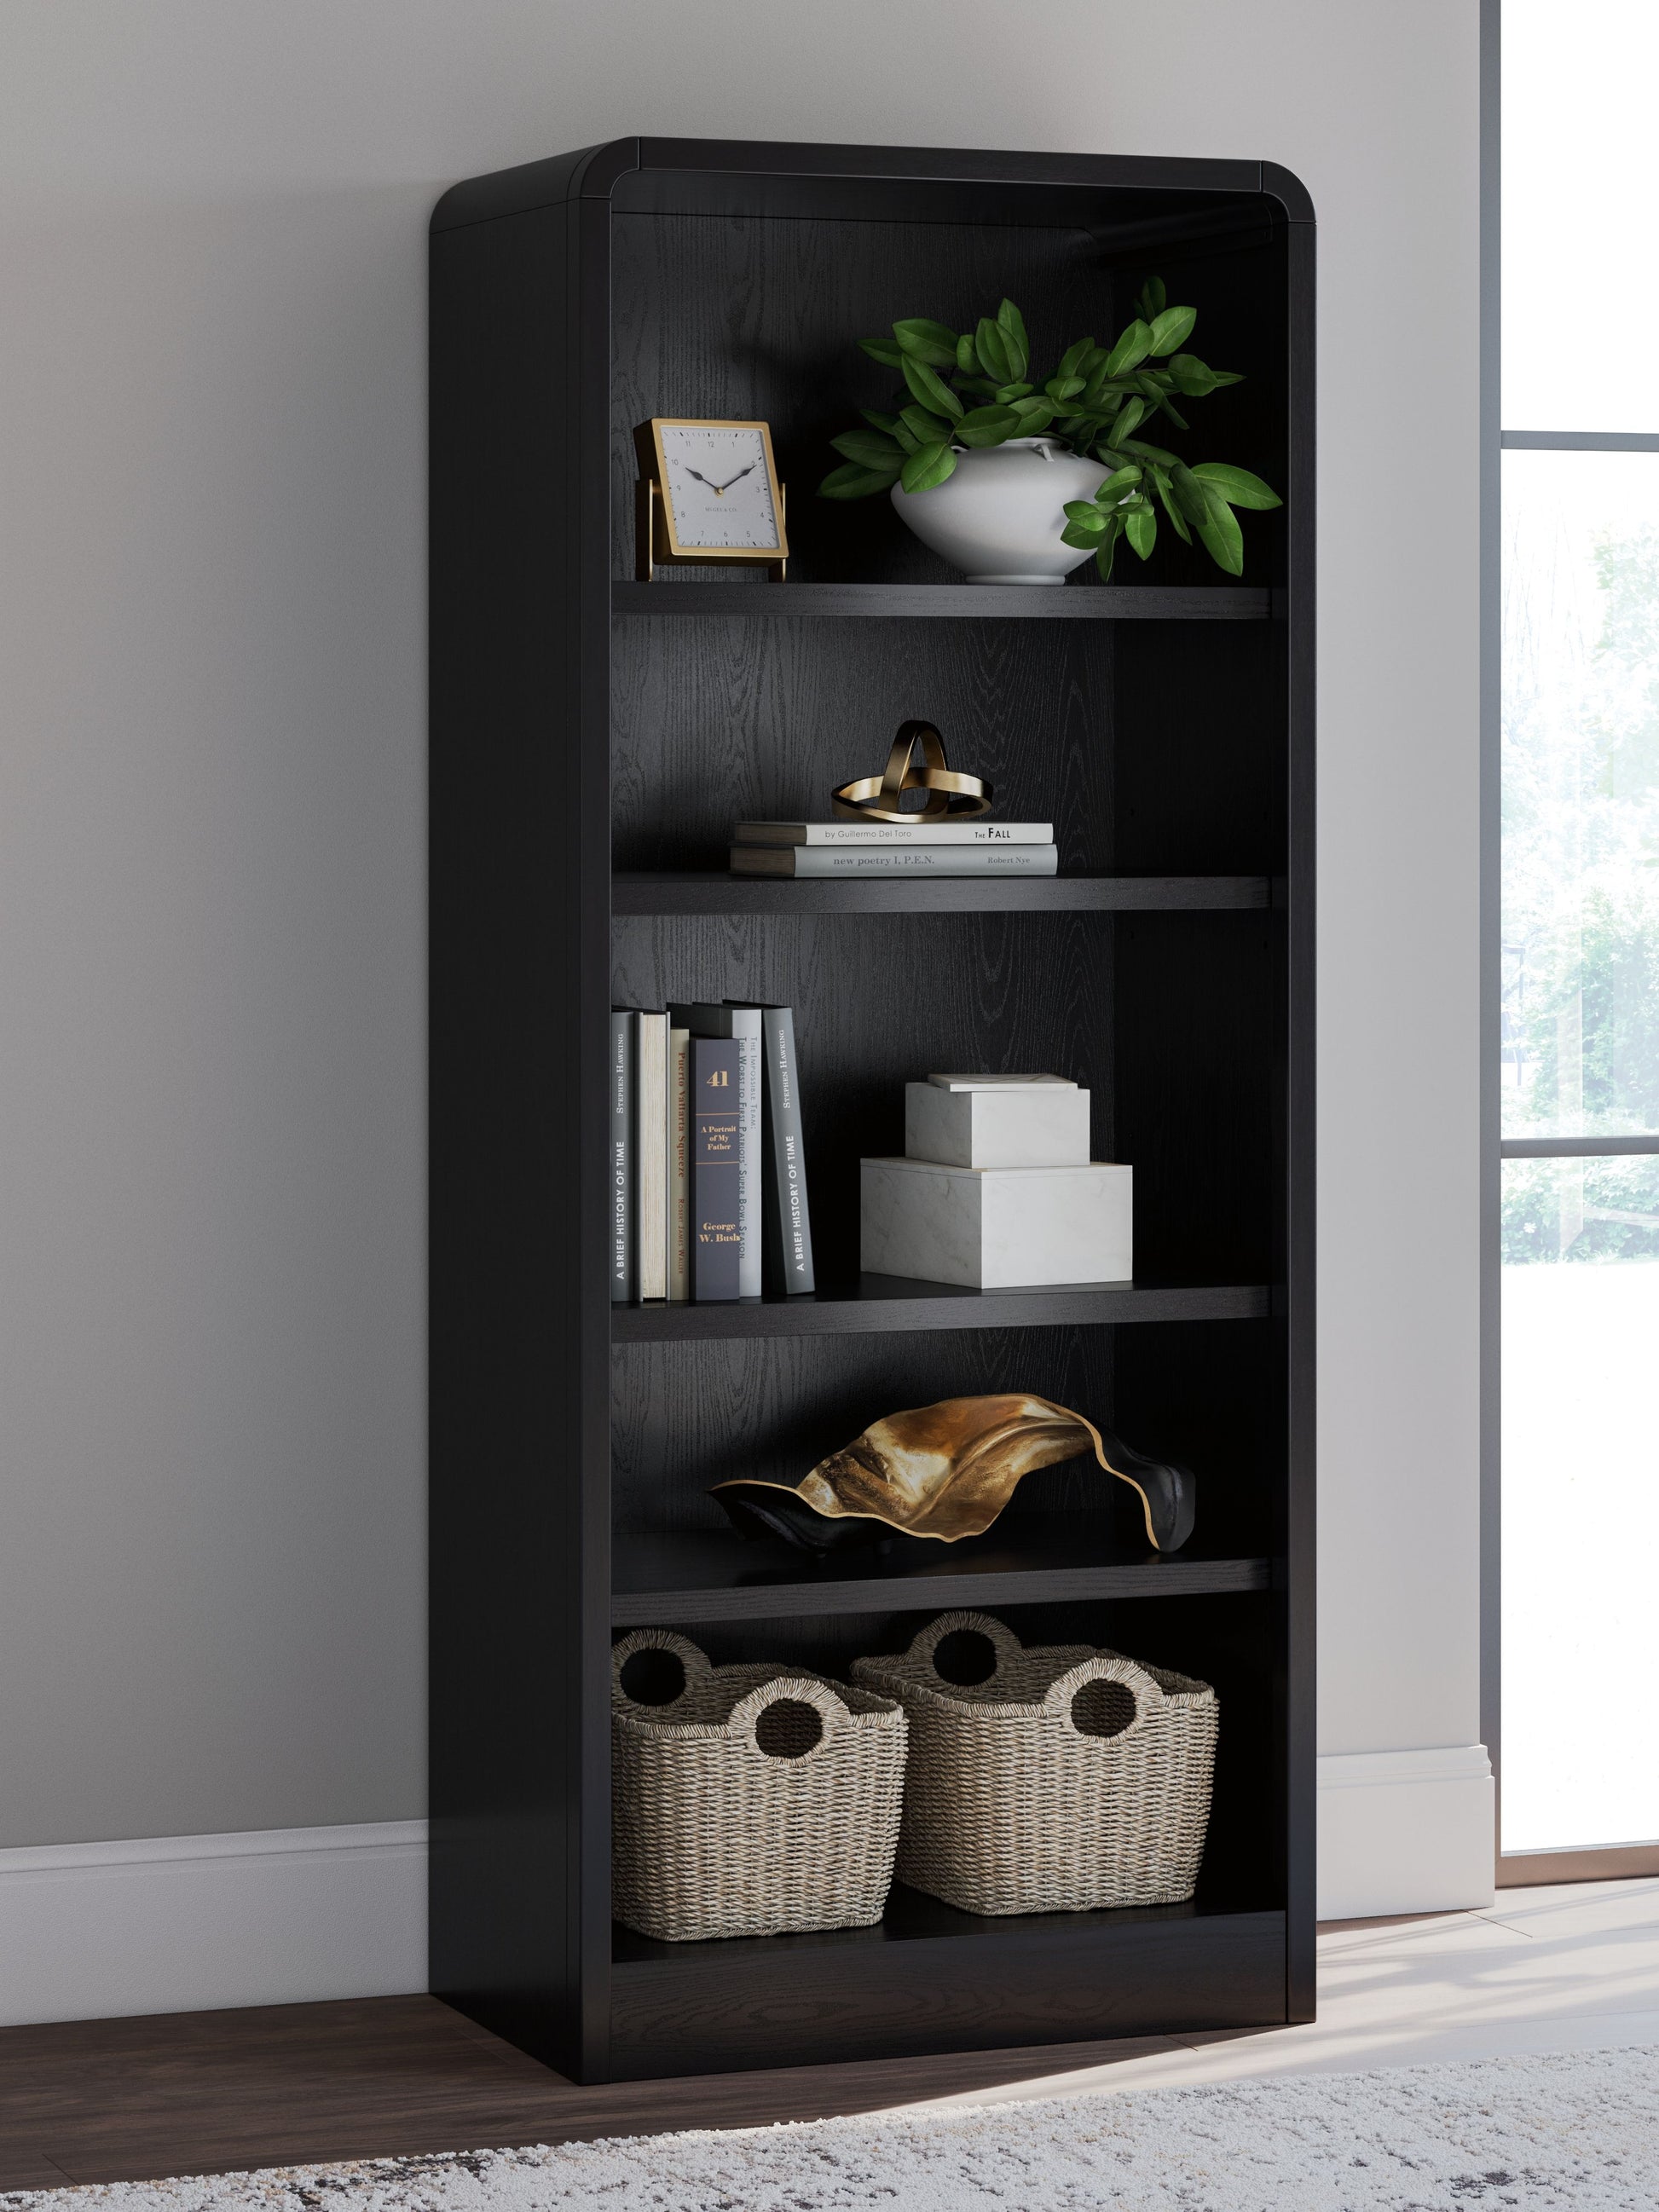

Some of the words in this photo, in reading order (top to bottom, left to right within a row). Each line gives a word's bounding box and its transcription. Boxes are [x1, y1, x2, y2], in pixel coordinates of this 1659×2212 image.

[824, 830, 835, 839] by
[837, 829, 876, 838] Guillermo
[988, 827, 1010, 839] FALL
[858, 857, 891, 867] poetry
[905, 855, 934, 864] P.E.N.
[987, 856, 1014, 864] Robert
[1015, 856, 1031, 865] Nye
[738, 1037, 747, 1052] THE
[738, 1056, 747, 1084] WORST
[706, 1071, 729, 1087] 41
[738, 1103, 747, 1123] FIRST
[708, 1125, 737, 1134] Portrait
[718, 1134, 729, 1143] My
[616, 1141, 625, 1166] TIME
[786, 1135, 795, 1161] TIME
[676, 1135, 685, 1178] Squeeze
[616, 1170, 625, 1186] OF
[789, 1164, 797, 1179] OF
[616, 1189, 625, 1235] HISTORY
[789, 1183, 801, 1227] HISTORY
[702, 1222, 736, 1233] George
[699, 1233, 714, 1243] W.
[715, 1233, 741, 1243] Bush
[794, 1231, 803, 1260] BRIEF
[616, 1239, 625, 1268] BRIEF
[796, 1262, 805, 1271] A
[616, 1271, 625, 1279] A
